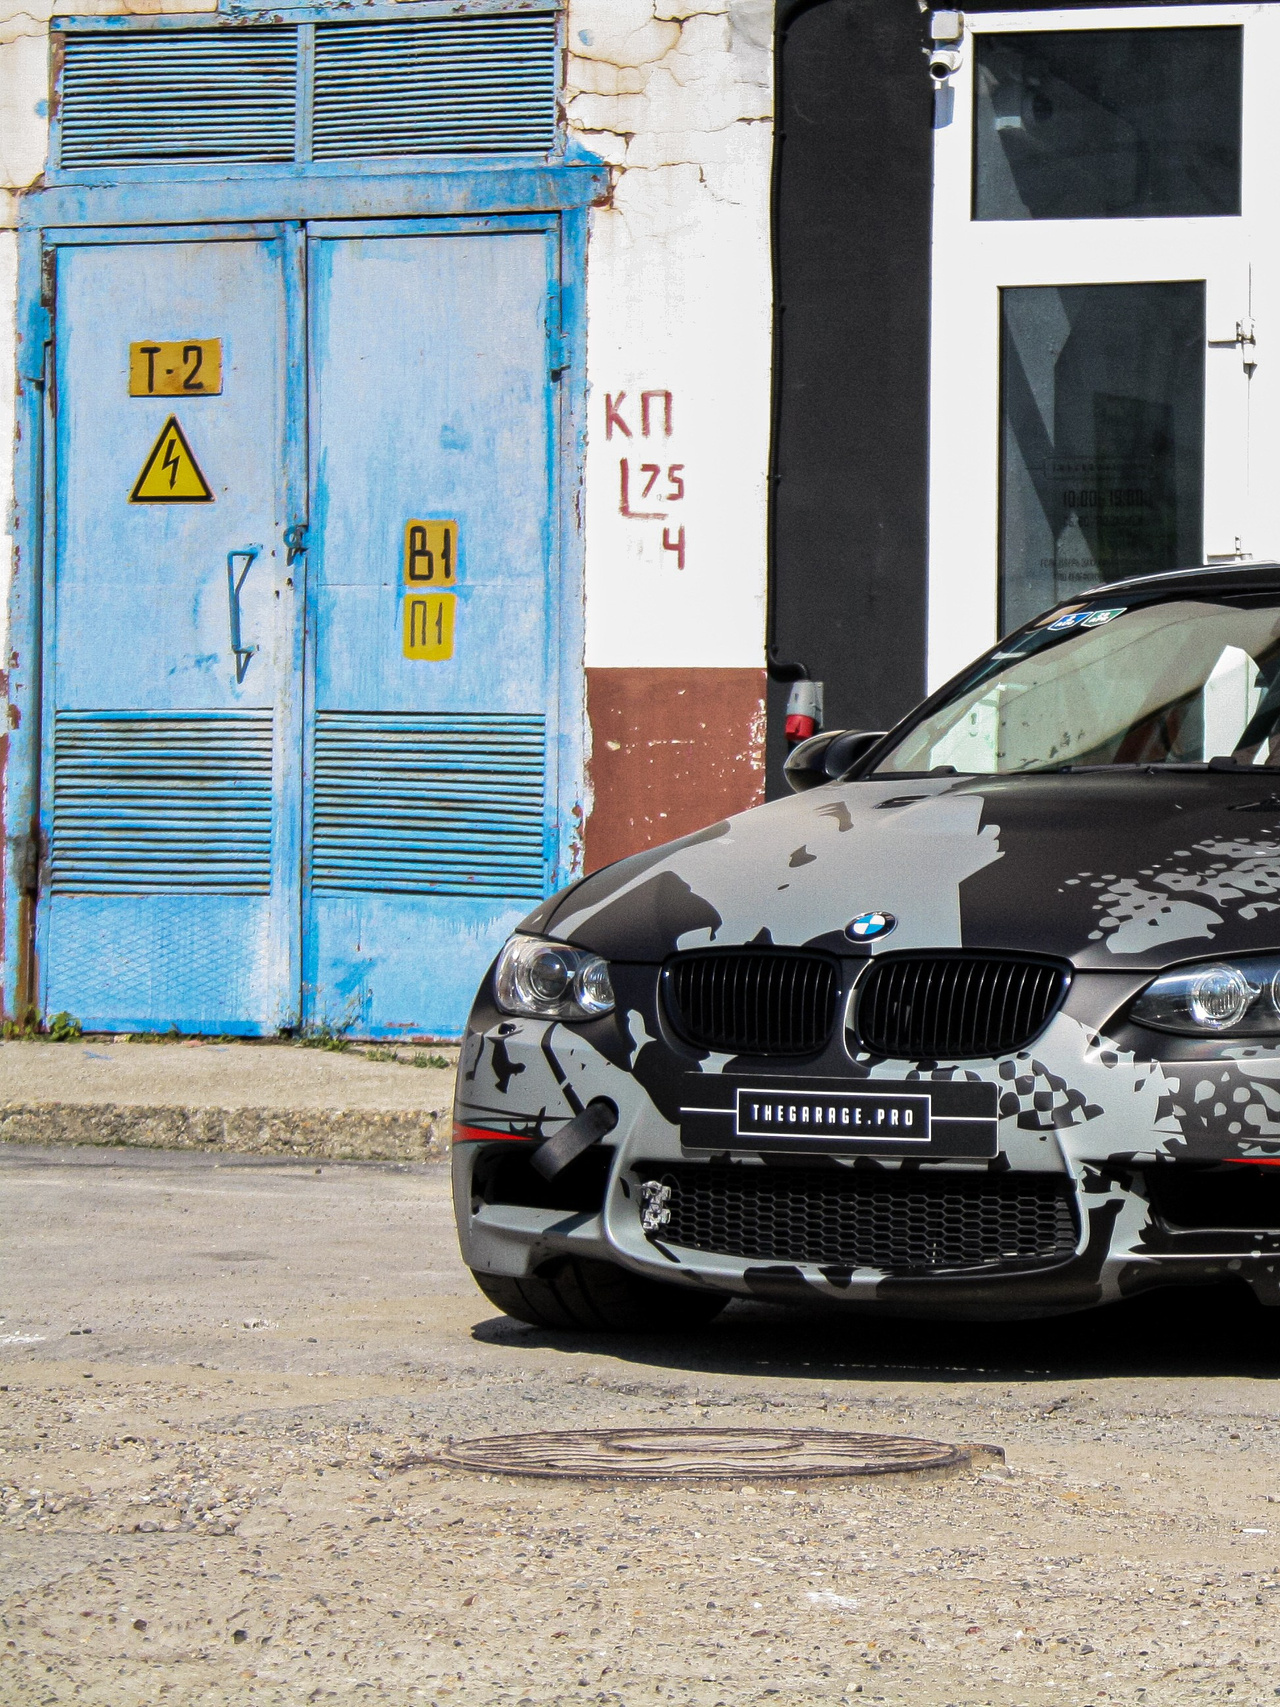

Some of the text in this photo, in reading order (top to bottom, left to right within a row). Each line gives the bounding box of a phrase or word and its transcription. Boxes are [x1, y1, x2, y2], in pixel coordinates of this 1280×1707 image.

[140, 345, 204, 393] Т-2
[604, 389, 673, 441] КП
[409, 525, 451, 581] В1
[410, 600, 443, 648] П1
[753, 1104, 913, 1126] THEGARAGE.PRO
